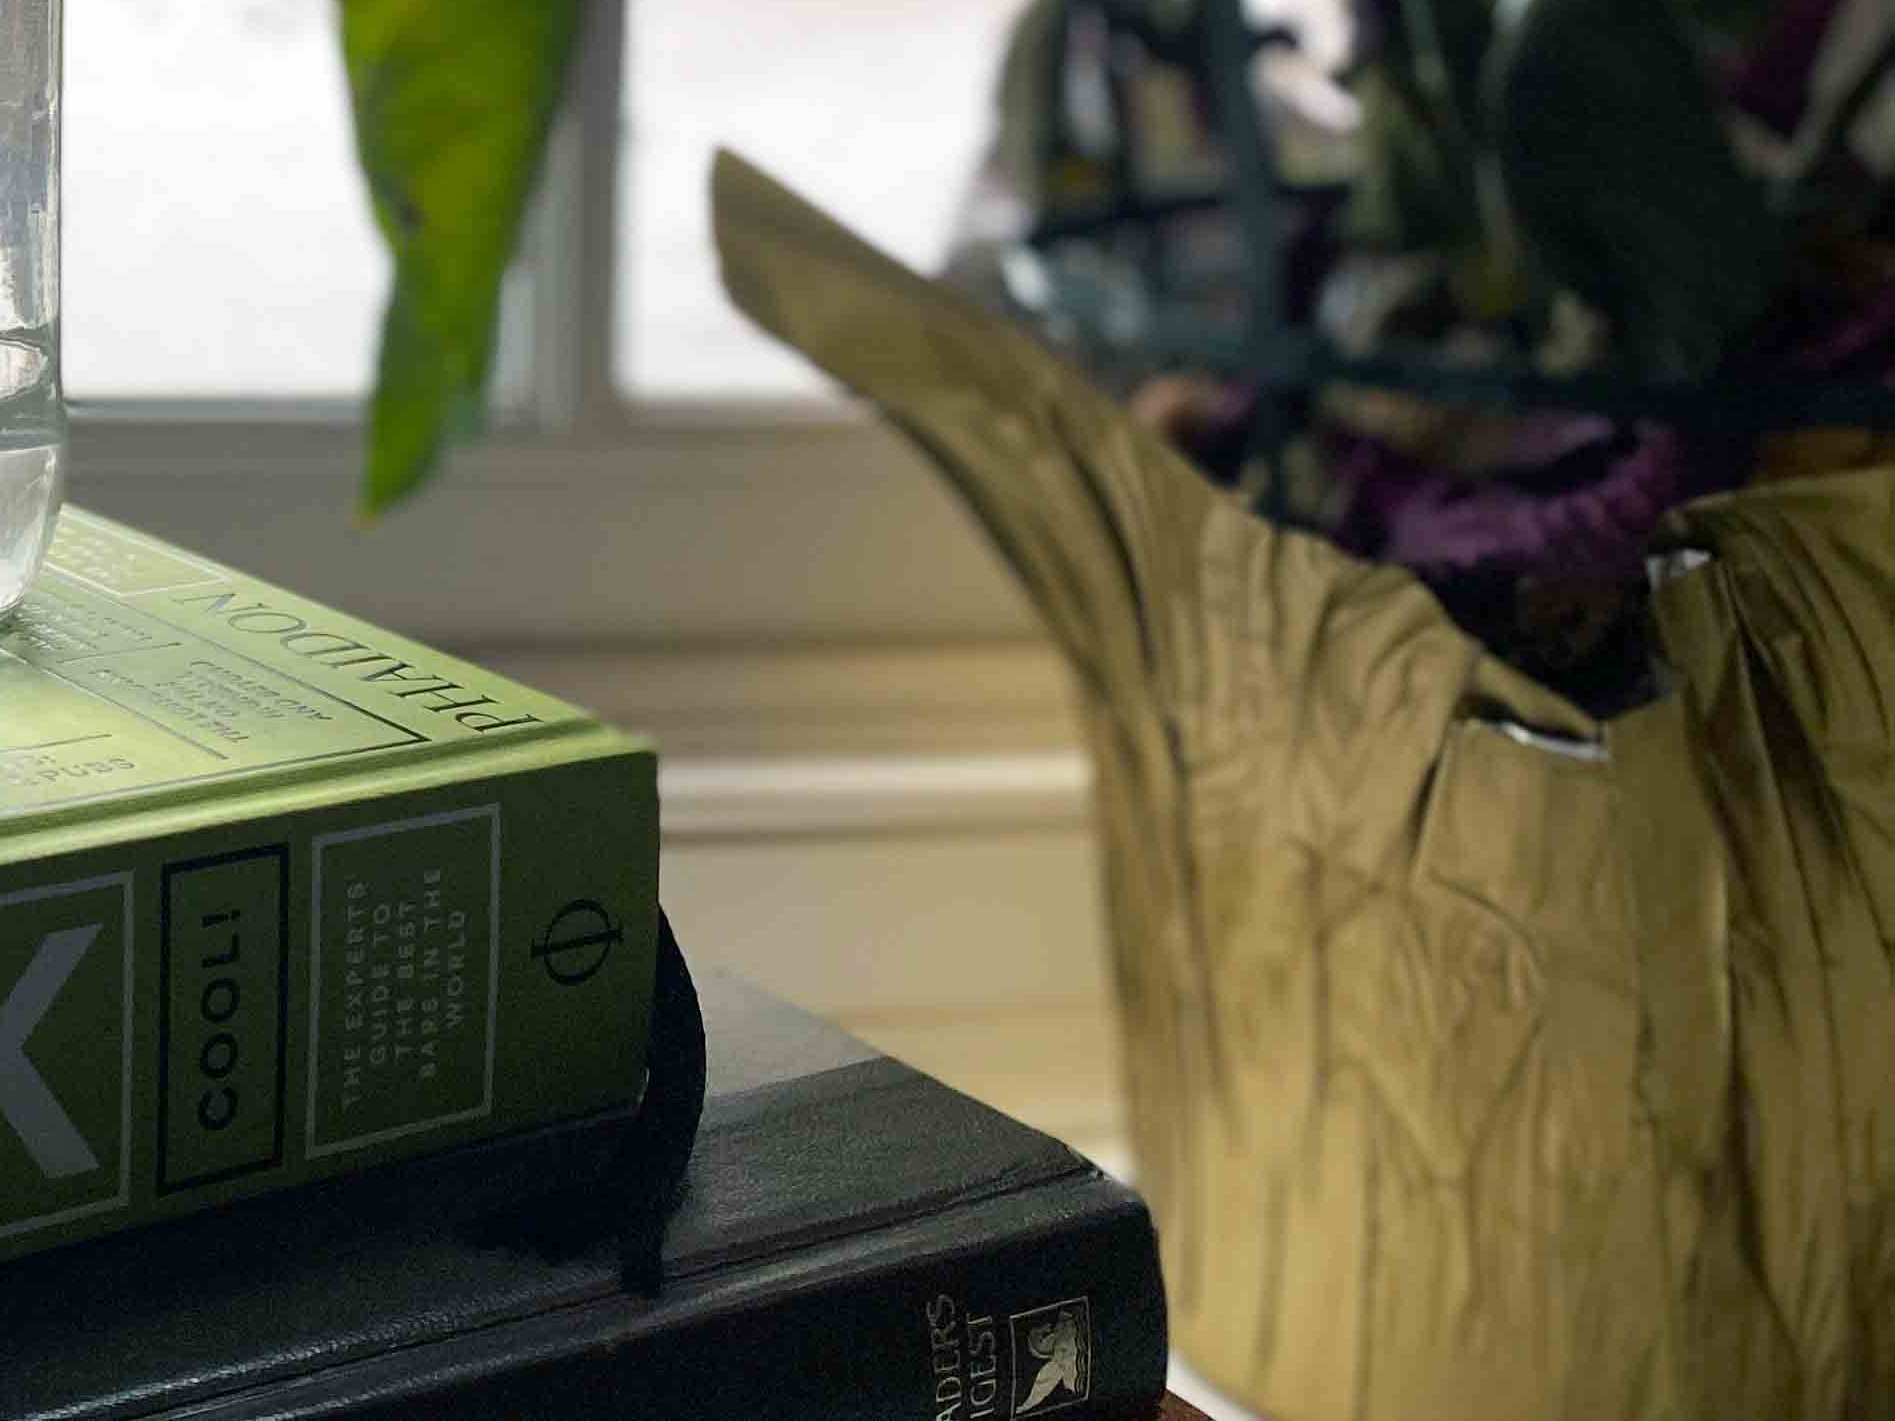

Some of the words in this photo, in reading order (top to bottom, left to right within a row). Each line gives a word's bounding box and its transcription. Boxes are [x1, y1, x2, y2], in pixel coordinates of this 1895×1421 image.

[170, 592, 545, 734] PHAIDON
[38, 754, 136, 783] PUBS
[372, 903, 392, 948] TO
[423, 868, 442, 931] THE
[397, 900, 418, 980] BEST
[423, 948, 442, 980] IN
[446, 910, 466, 1030] WORLD
[198, 909, 241, 1131] COOL!
[368, 962, 391, 1066] GUIDE
[395, 996, 416, 1060] THE
[419, 997, 440, 1078] BARS
[342, 1046, 362, 1111] THE
[925, 1293, 964, 1421] ADER'S
[967, 1312, 998, 1421] IGEST
